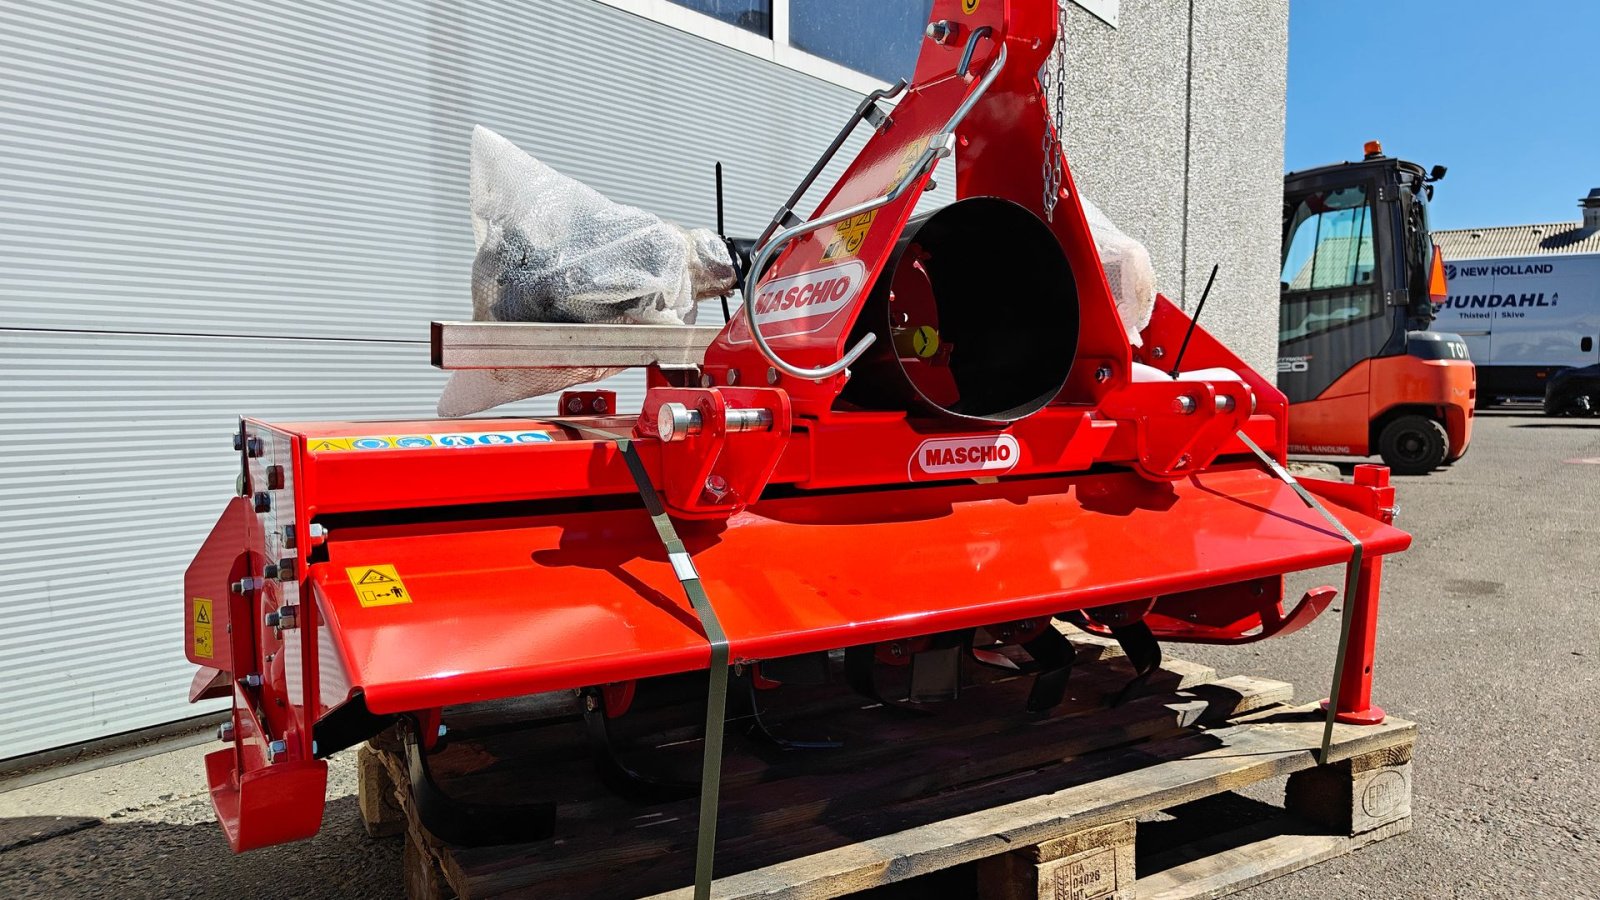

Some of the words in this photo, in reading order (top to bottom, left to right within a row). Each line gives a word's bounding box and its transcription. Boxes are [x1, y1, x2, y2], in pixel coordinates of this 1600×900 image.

[1460, 266, 1489, 277] NEW
[1491, 264, 1553, 276] HOLLAND
[755, 275, 851, 315] MASCHIO
[1501, 311, 1525, 319] Skive
[925, 444, 1011, 466] MASCHIO
[1312, 445, 1350, 454] HANDLING
